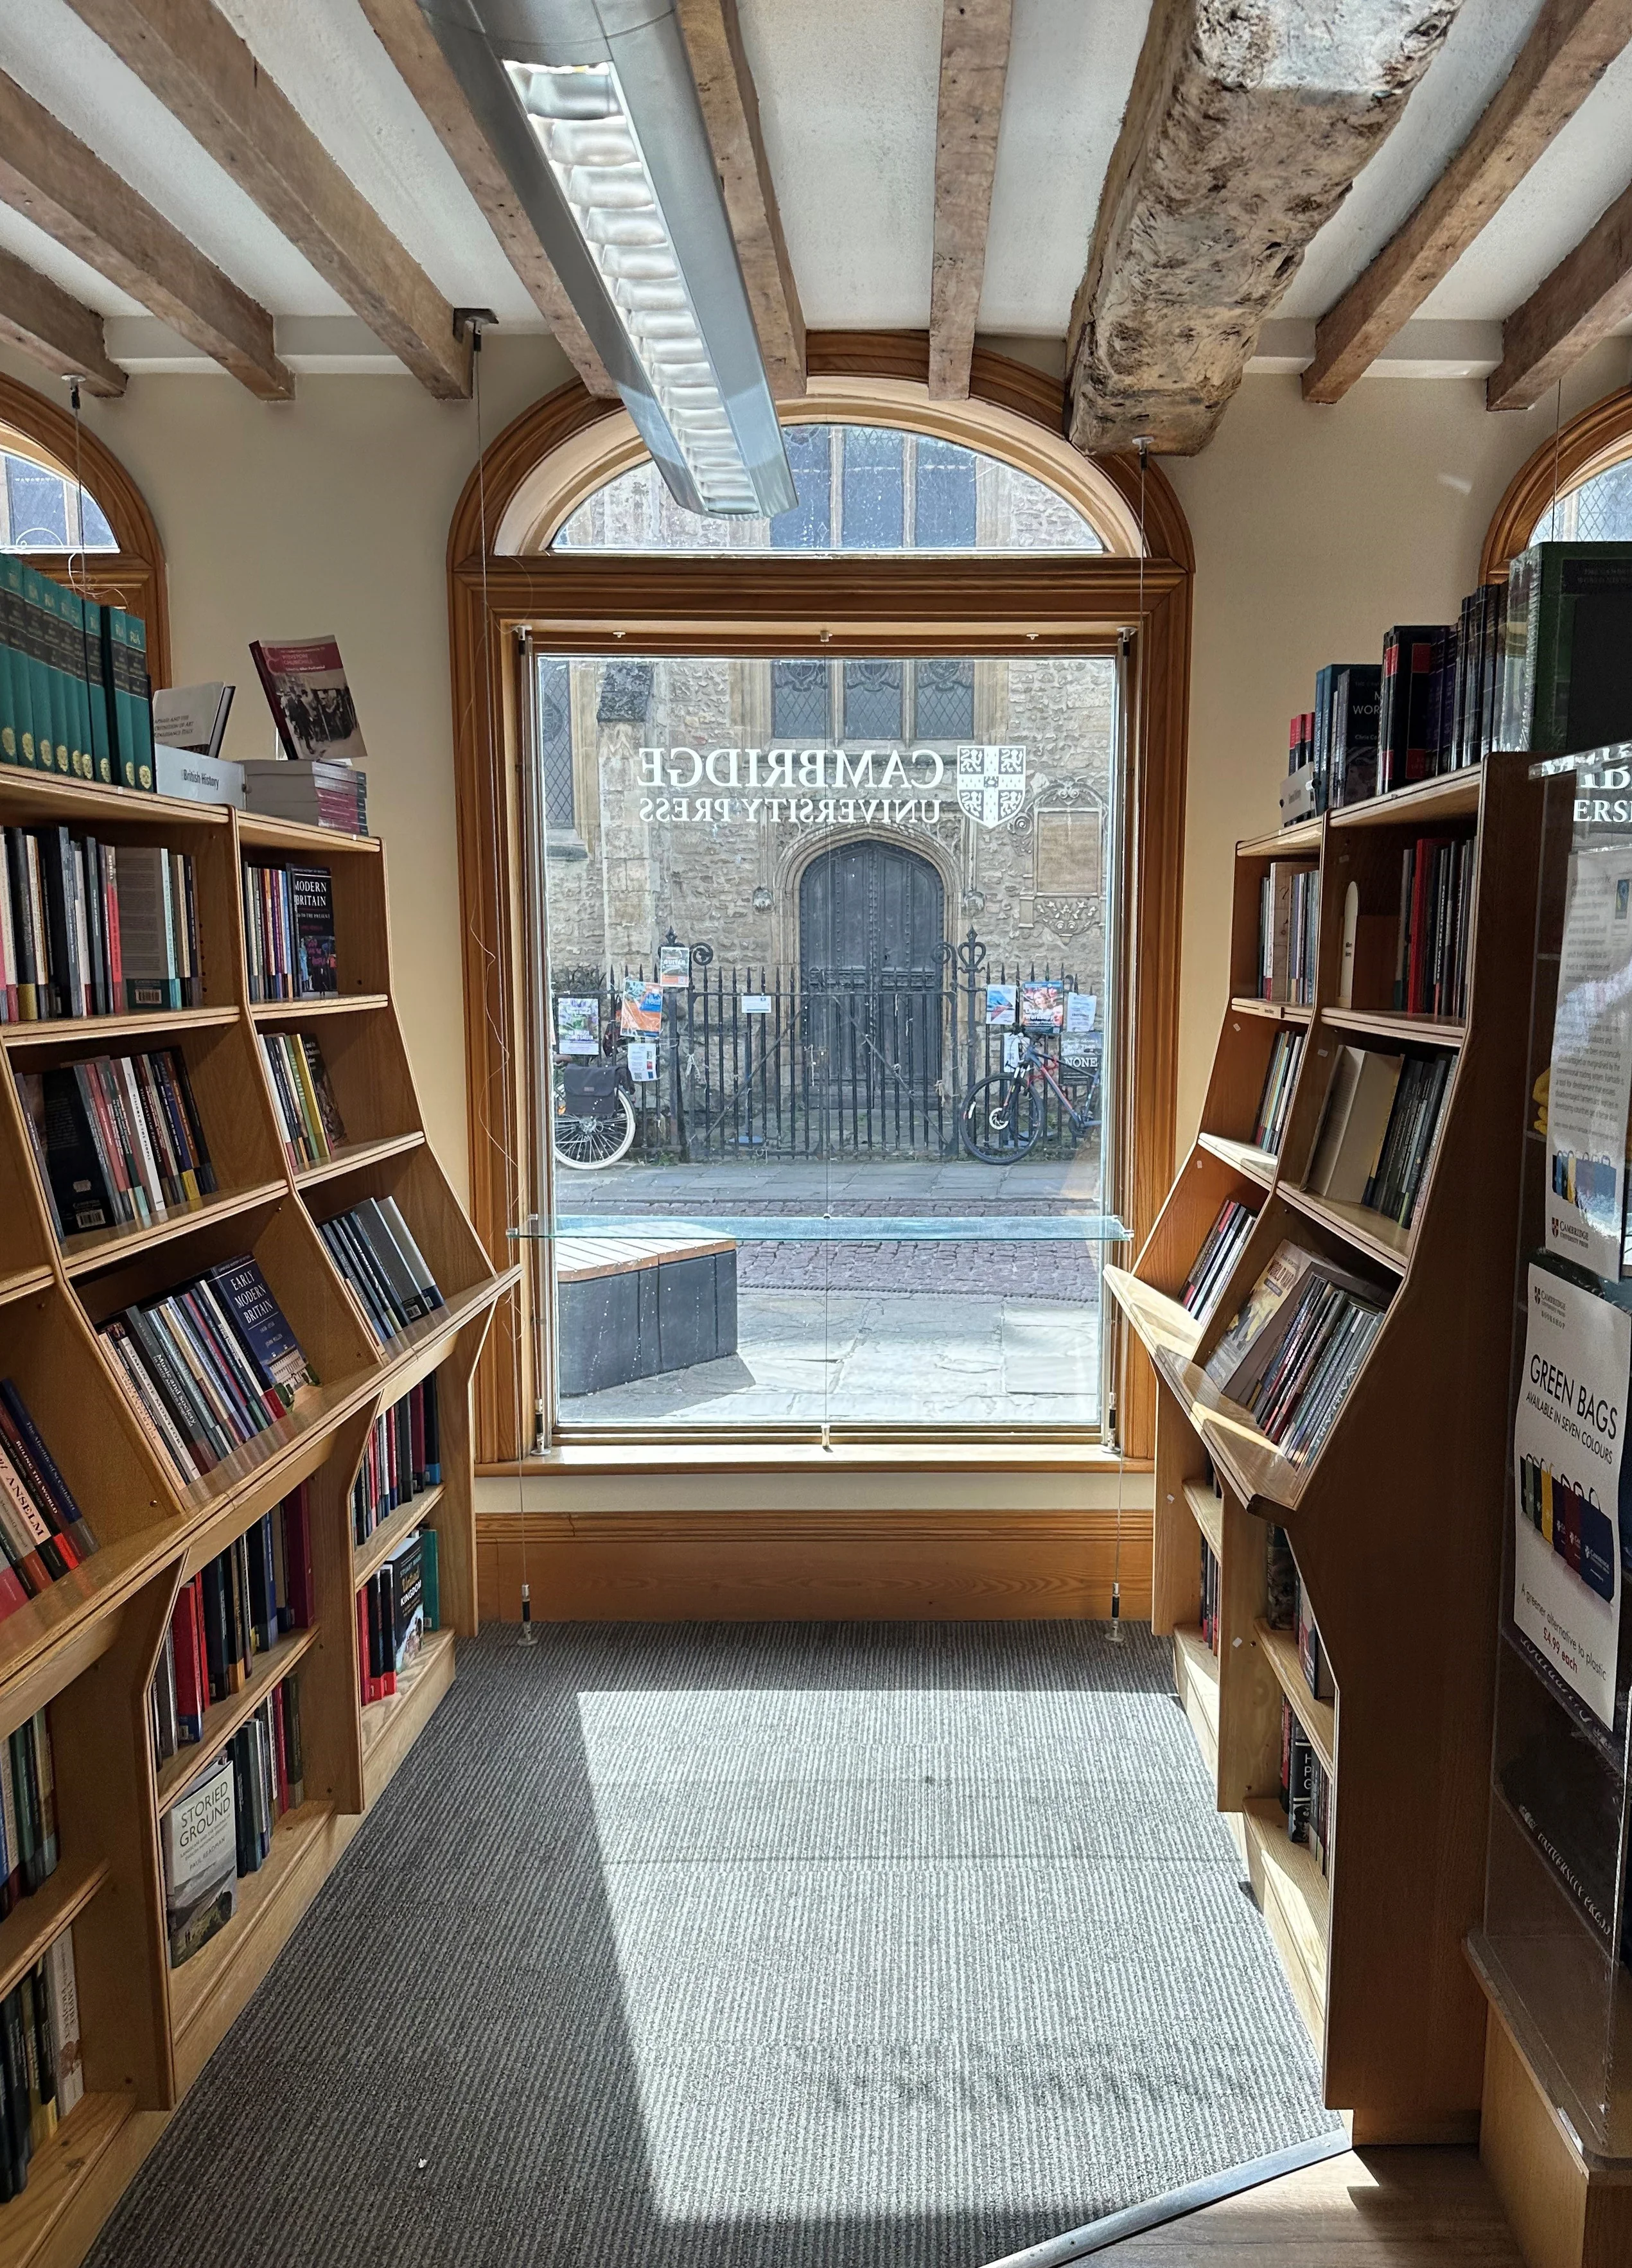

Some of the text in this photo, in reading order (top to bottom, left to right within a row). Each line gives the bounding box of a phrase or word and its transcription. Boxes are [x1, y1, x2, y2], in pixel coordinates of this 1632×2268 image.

[183, 769, 219, 790] British History
[295, 881, 326, 892] MODERN
[295, 895, 326, 906] BRITAIN
[1064, 1057, 1098, 1068] NONE
[143, 1139, 151, 1160] PEOPLE
[1559, 1221, 1589, 1241] CAMBRIDGE
[231, 1269, 254, 1290] EARLY
[235, 1283, 267, 1308] MODERN
[243, 1298, 274, 1324] BRITAIN
[1541, 1290, 1566, 1311] CAMBRIDGE
[128, 1348, 184, 1449] SIMON DE MONTFORT
[155, 1353, 197, 1425] Music and Society
[1531, 1354, 1618, 1439] GREEN BAGS
[1526, 1391, 1613, 1464] AVAILABLE IN SEVEN COLOURS
[15, 1439, 58, 1514] RULING THE WORLD
[24, 1420, 35, 1434] The
[32, 1435, 50, 1462] Afterlife
[55, 1478, 76, 1509] Cuthbert
[6, 1474, 44, 1536] ANSELM
[400, 1581, 422, 1607] KINGDOM
[1521, 1583, 1607, 1681] A greener alternative to plastic
[1543, 1627, 1577, 1674] £4.99 each
[180, 1797, 231, 1848] GROUND
[181, 1780, 229, 1829] STORIED
